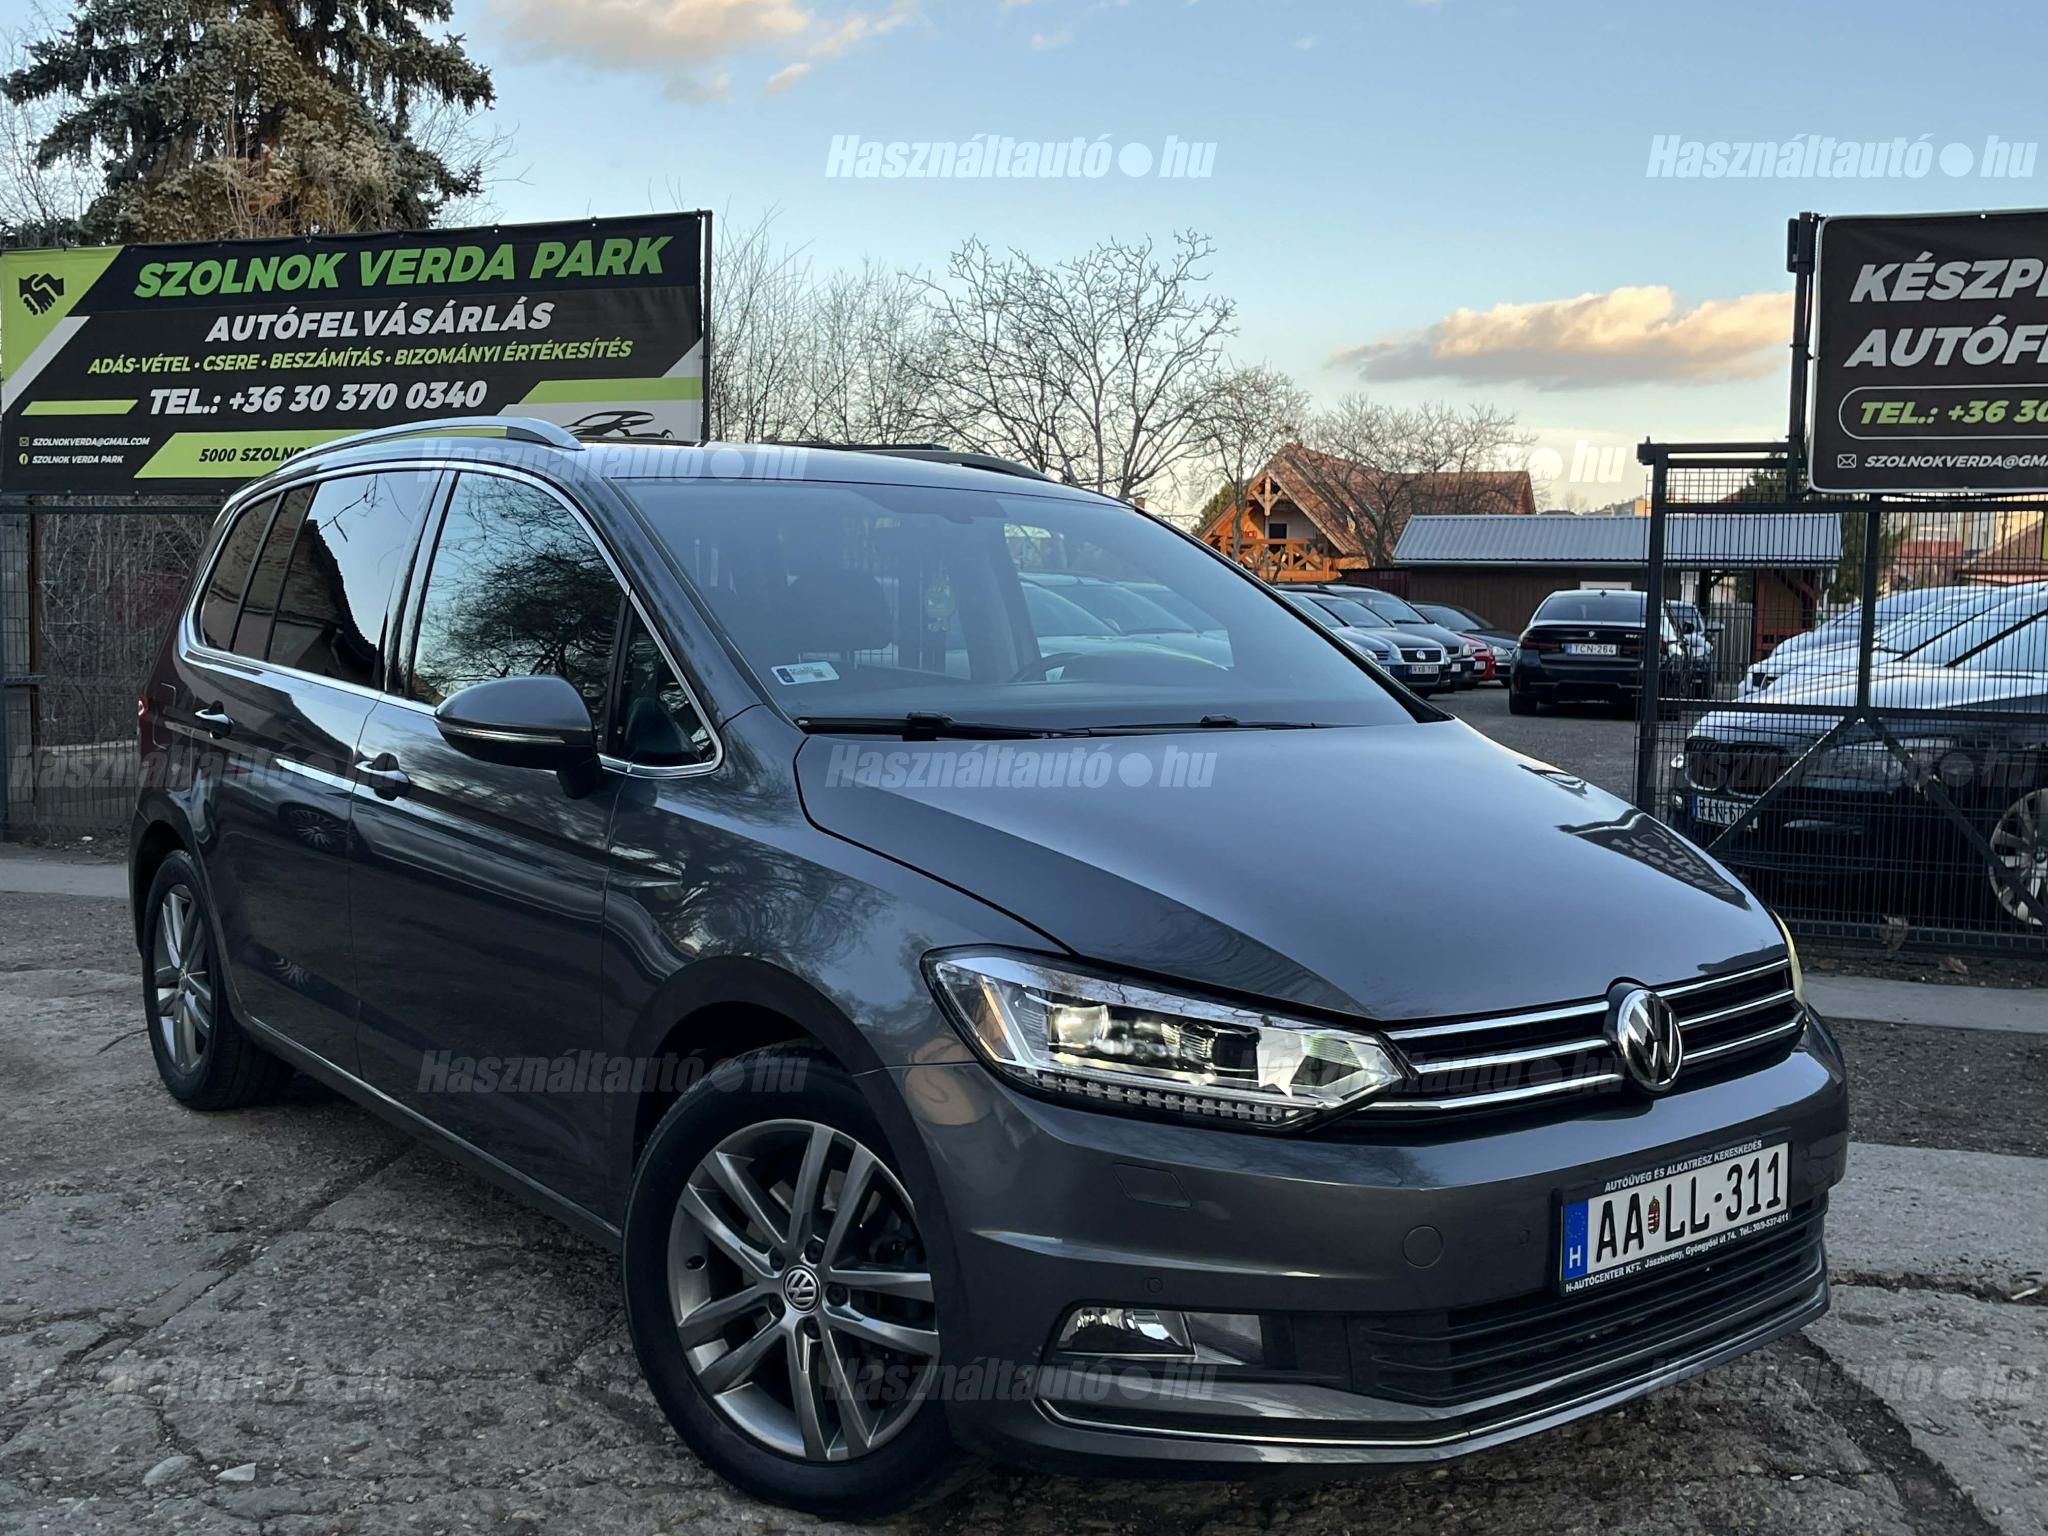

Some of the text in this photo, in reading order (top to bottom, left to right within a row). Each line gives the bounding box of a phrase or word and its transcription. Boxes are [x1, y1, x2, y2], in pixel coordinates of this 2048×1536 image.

[134, 236, 674, 297] SZOLNOK VERDA PARK
[1849, 250, 2048, 302] KÉSZP
[204, 296, 555, 342] AUTÓFELVÁSÁRLÁS
[87, 336, 633, 374] ADÁS-VÉTEL CSERE BESZÁMÍTÁS BIZOMÁNYI ÉRTÉKESÍTÉS
[1843, 314, 2048, 367] AUTÓF
[150, 380, 487, 415] TEL.: +36 30 370 0340
[1860, 401, 1939, 424] TEL.:
[1948, 400, 2009, 423] +36
[32, 437, 150, 447] SZOLNOKVERDA@GMAIL.COM
[32, 455, 124, 464] SZOLNOK VERDA PARK
[199, 447, 312, 462] 5000 SZOLN
[1865, 455, 2048, 469] SZOLNOKVERDA@GM
[1596, 1192, 1644, 1262] AA
[1569, 1245, 1582, 1269] H
